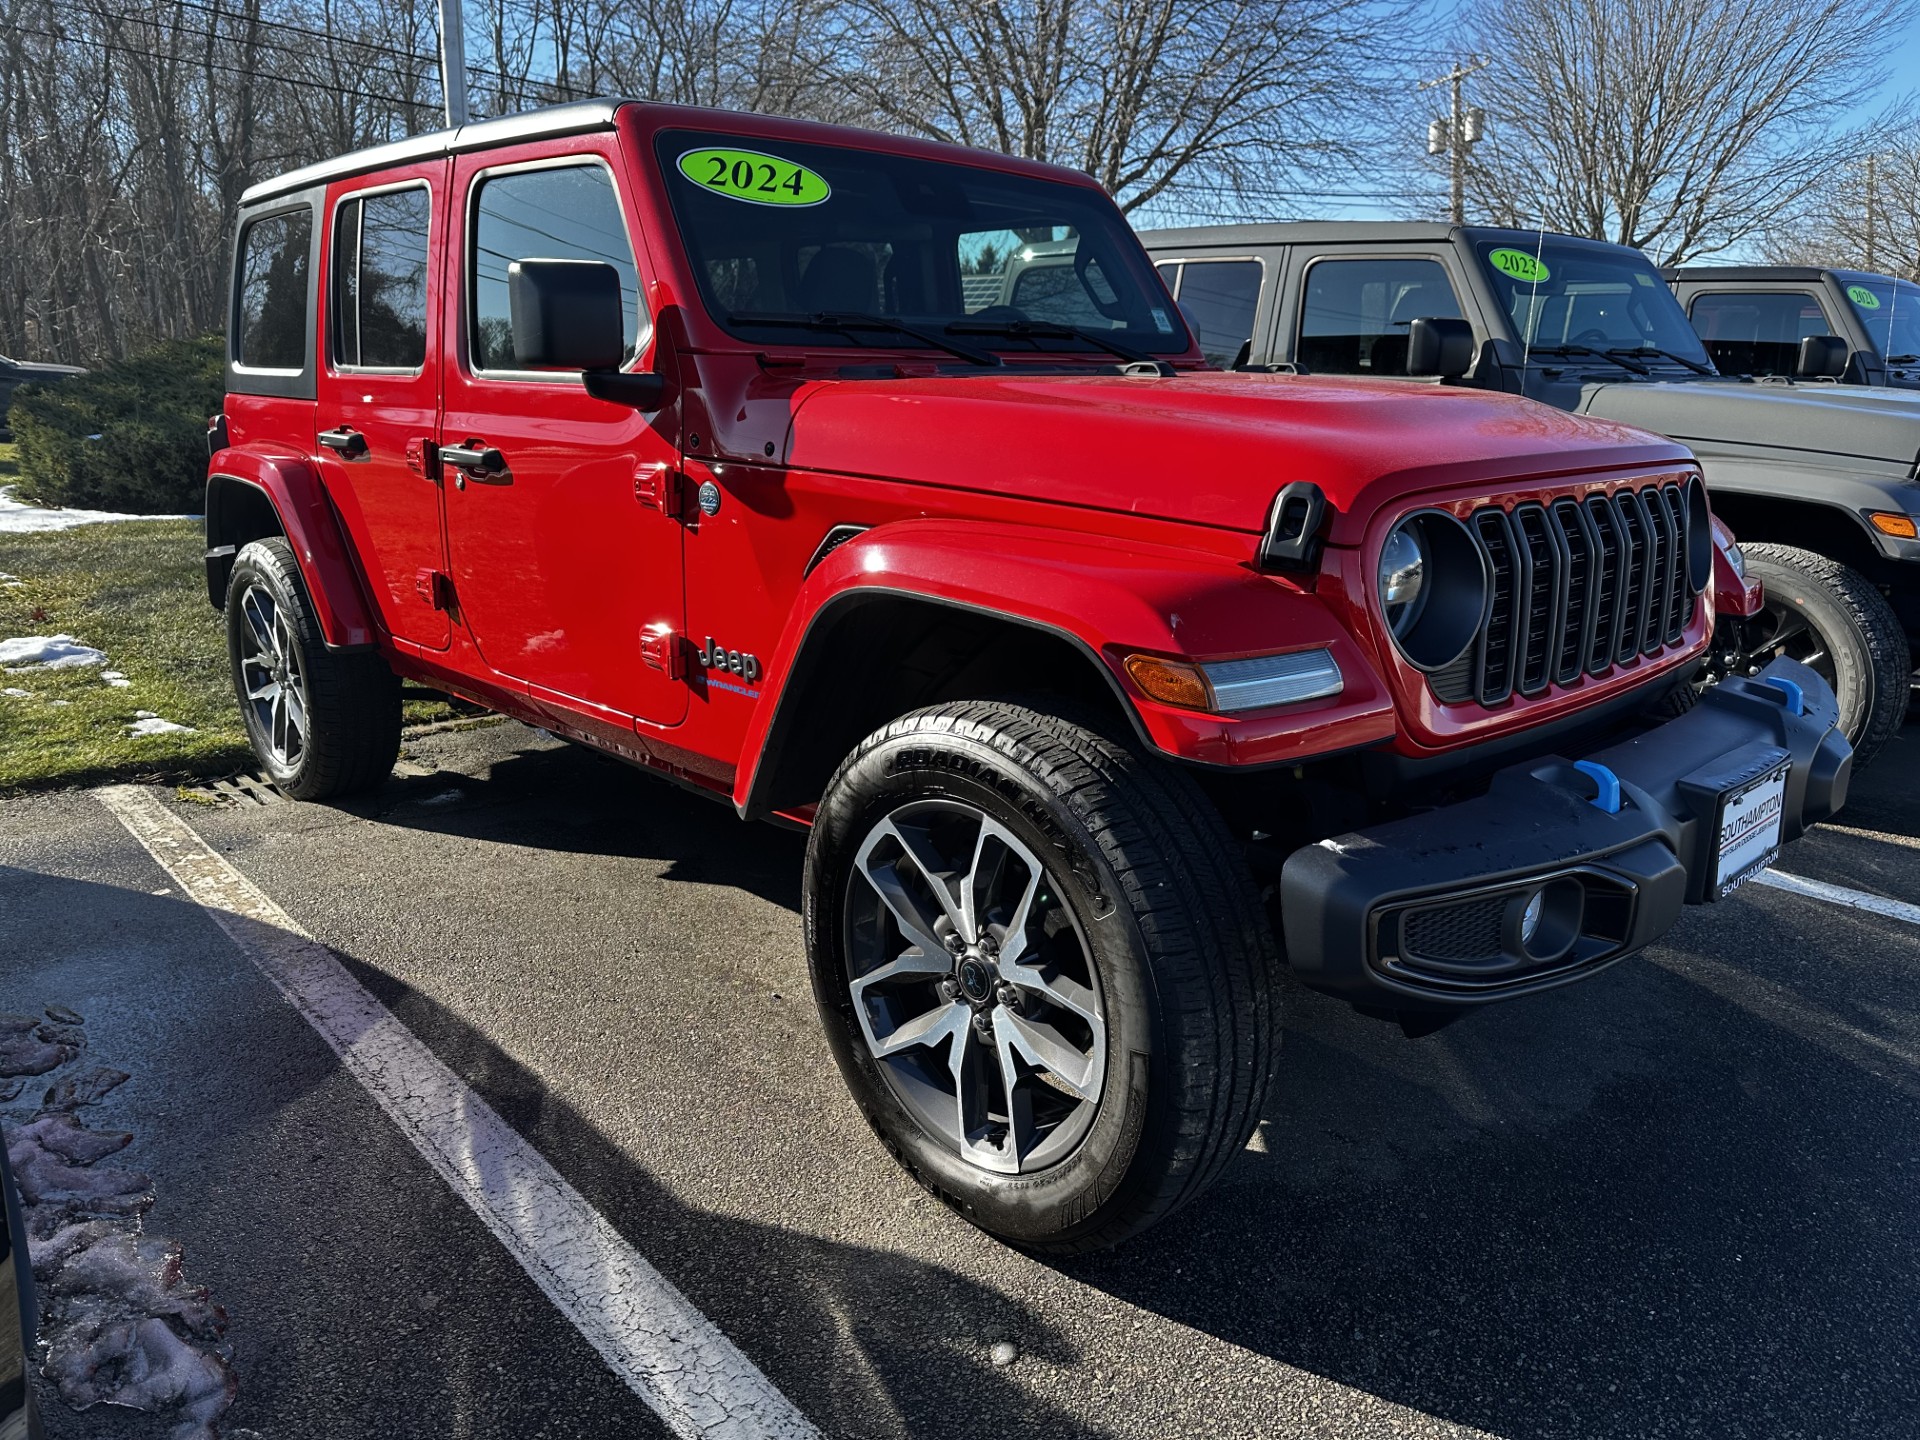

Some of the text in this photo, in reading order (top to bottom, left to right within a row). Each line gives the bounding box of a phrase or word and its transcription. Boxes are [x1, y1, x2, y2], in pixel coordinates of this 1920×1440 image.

[706, 156, 803, 196] 2024
[1500, 253, 1537, 276] 2023
[697, 635, 757, 684] Jeep
[1719, 791, 1782, 846] SOUTHAMPTON
[1721, 849, 1779, 898] SOUTHAMPTON
